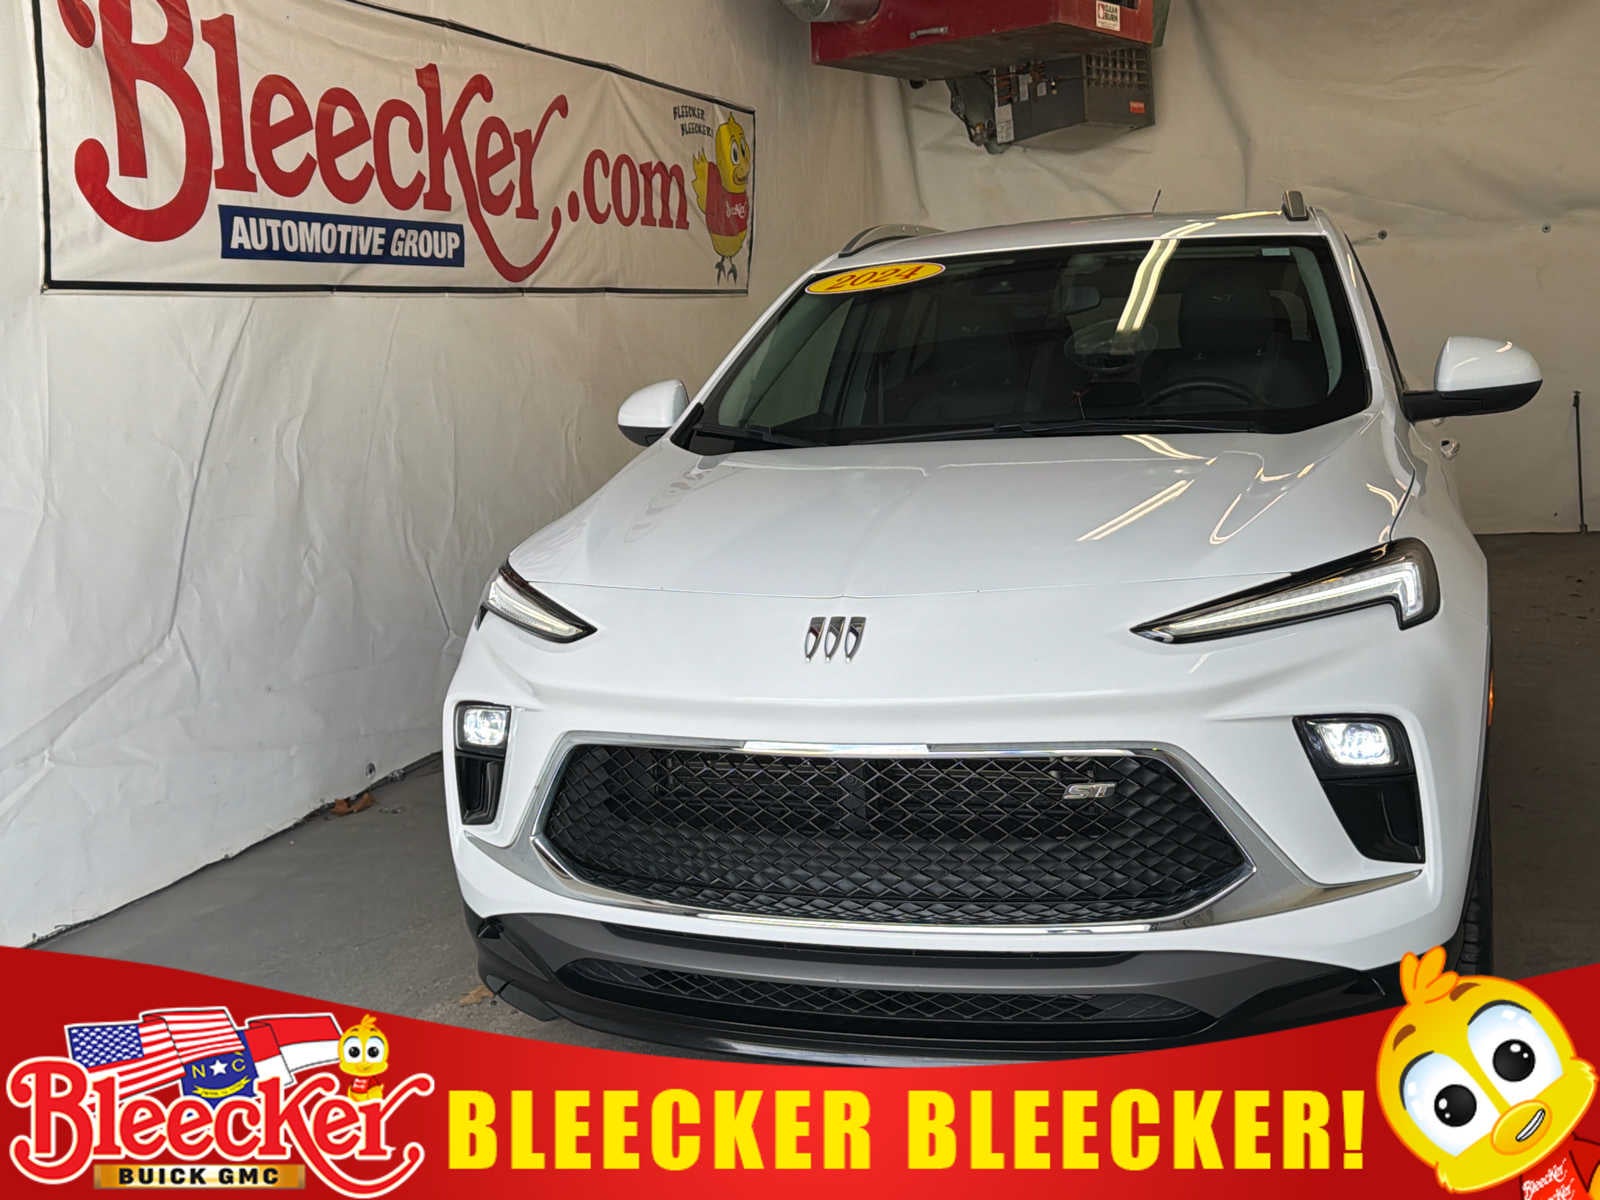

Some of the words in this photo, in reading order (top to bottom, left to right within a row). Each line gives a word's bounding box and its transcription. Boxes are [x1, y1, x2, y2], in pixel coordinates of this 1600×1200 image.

[230, 216, 387, 257] AUTOMOTIVE
[390, 228, 462, 259] GROUP
[826, 264, 925, 291] 2024
